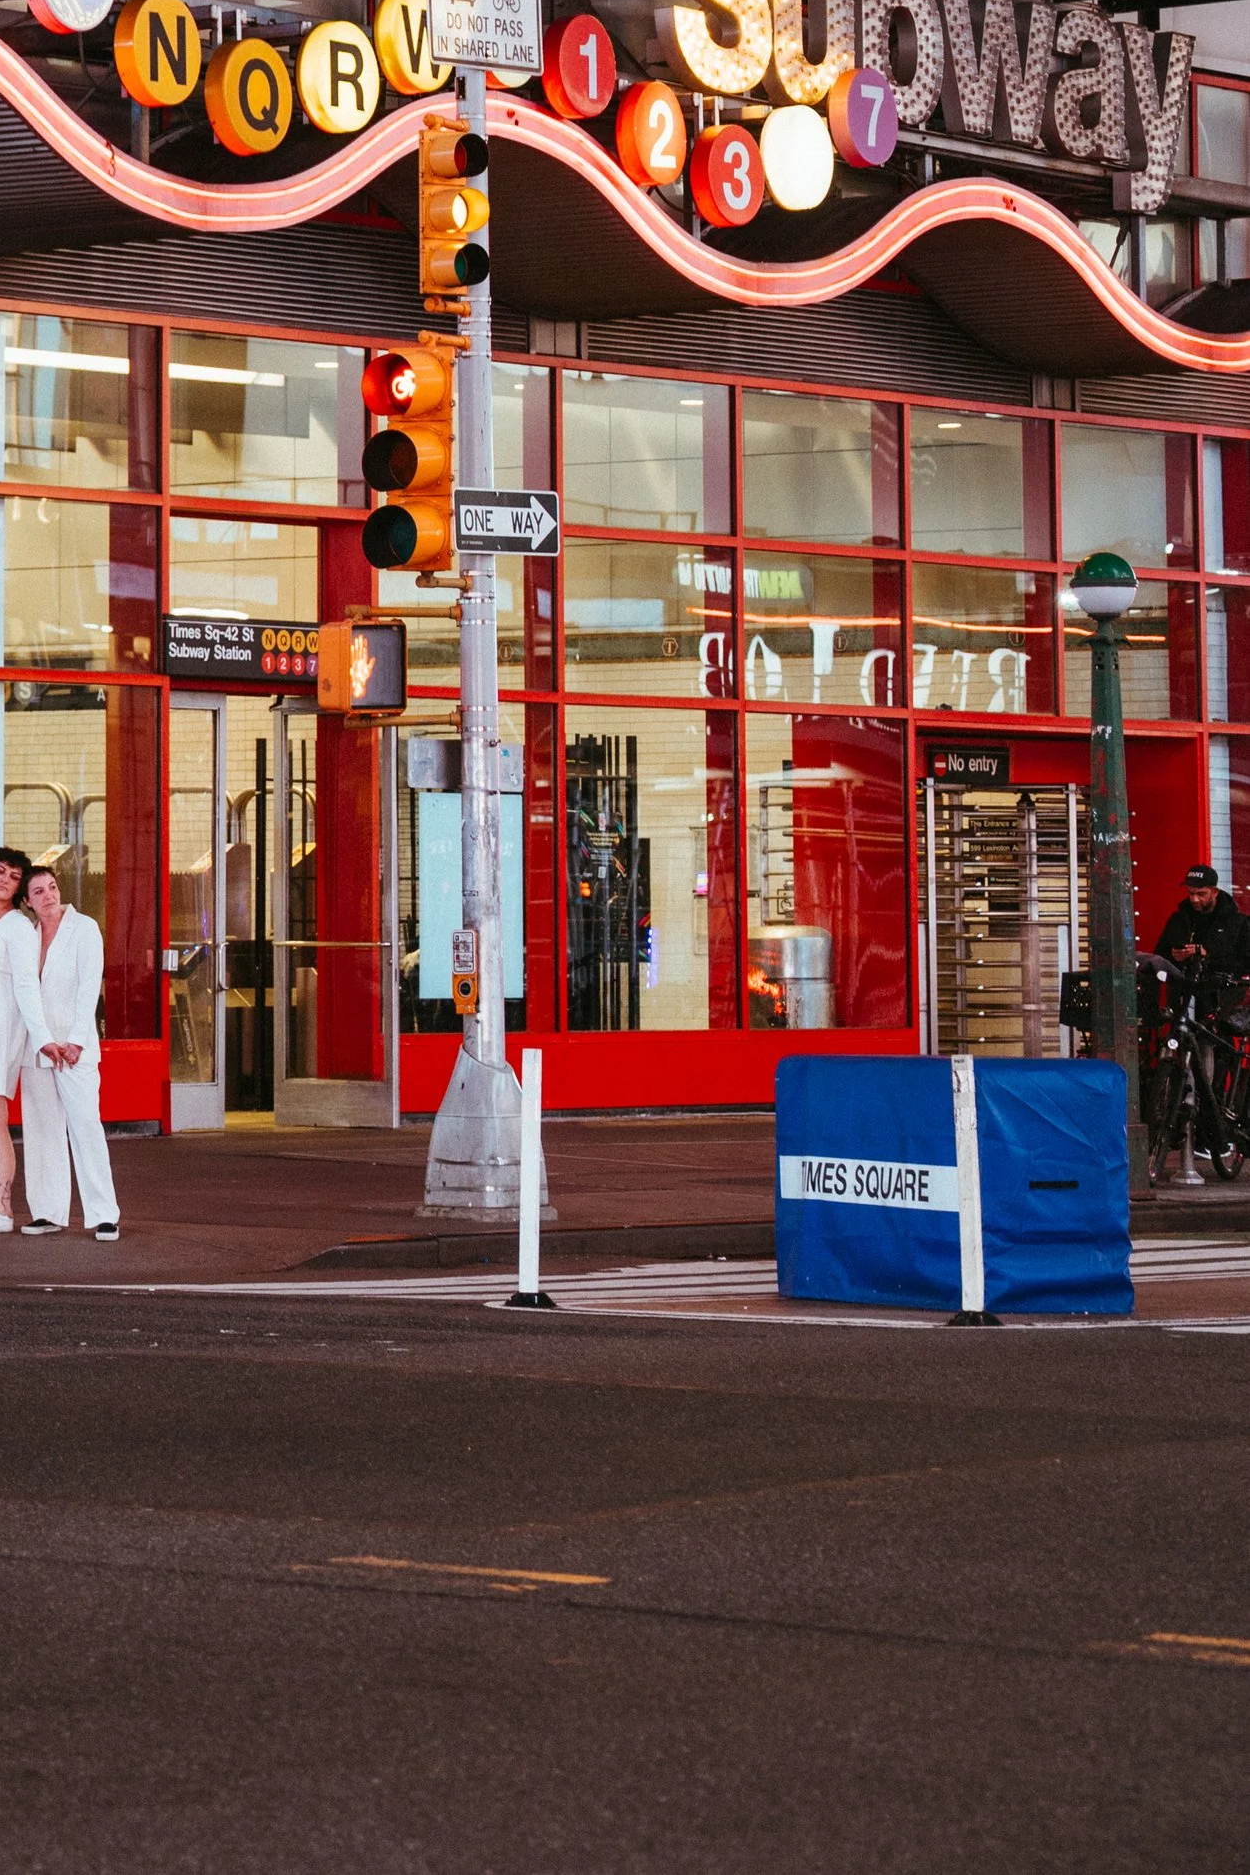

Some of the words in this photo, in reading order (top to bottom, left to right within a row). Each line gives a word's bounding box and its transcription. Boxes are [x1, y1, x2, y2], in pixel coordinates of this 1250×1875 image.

[447, 13, 462, 30] DO
[468, 16, 489, 34] NOT
[495, 19, 524, 38] PASS
[437, 35, 448, 52] IN
[455, 37, 499, 59] SHARED
[505, 43, 535, 63] LANE
[149, 10, 187, 87] N
[238, 58, 280, 137] Q
[330, 40, 365, 112] R
[579, 39, 598, 101] 1
[648, 97, 678, 169] 2
[722, 140, 752, 210] 3
[860, 84, 885, 148] 7
[464, 509, 494, 533] ONE
[511, 511, 544, 535] WAY
[169, 623, 202, 640] Times
[204, 625, 239, 643] Sq-42
[242, 627, 254, 643] St
[265, 633, 273, 645] N
[280, 634, 288, 646] Q
[295, 635, 302, 648] R
[309, 636, 318, 648] W
[168, 643, 210, 662] Subway
[214, 644, 252, 661] Station
[265, 657, 271, 669] 1
[280, 657, 288, 670] 2
[294, 659, 302, 671] 3
[309, 660, 317, 672] 7
[96, 688, 106, 702] A
[948, 754, 965, 772] No
[968, 755, 998, 776] entry
[853, 1164, 930, 1203] SQUARE
